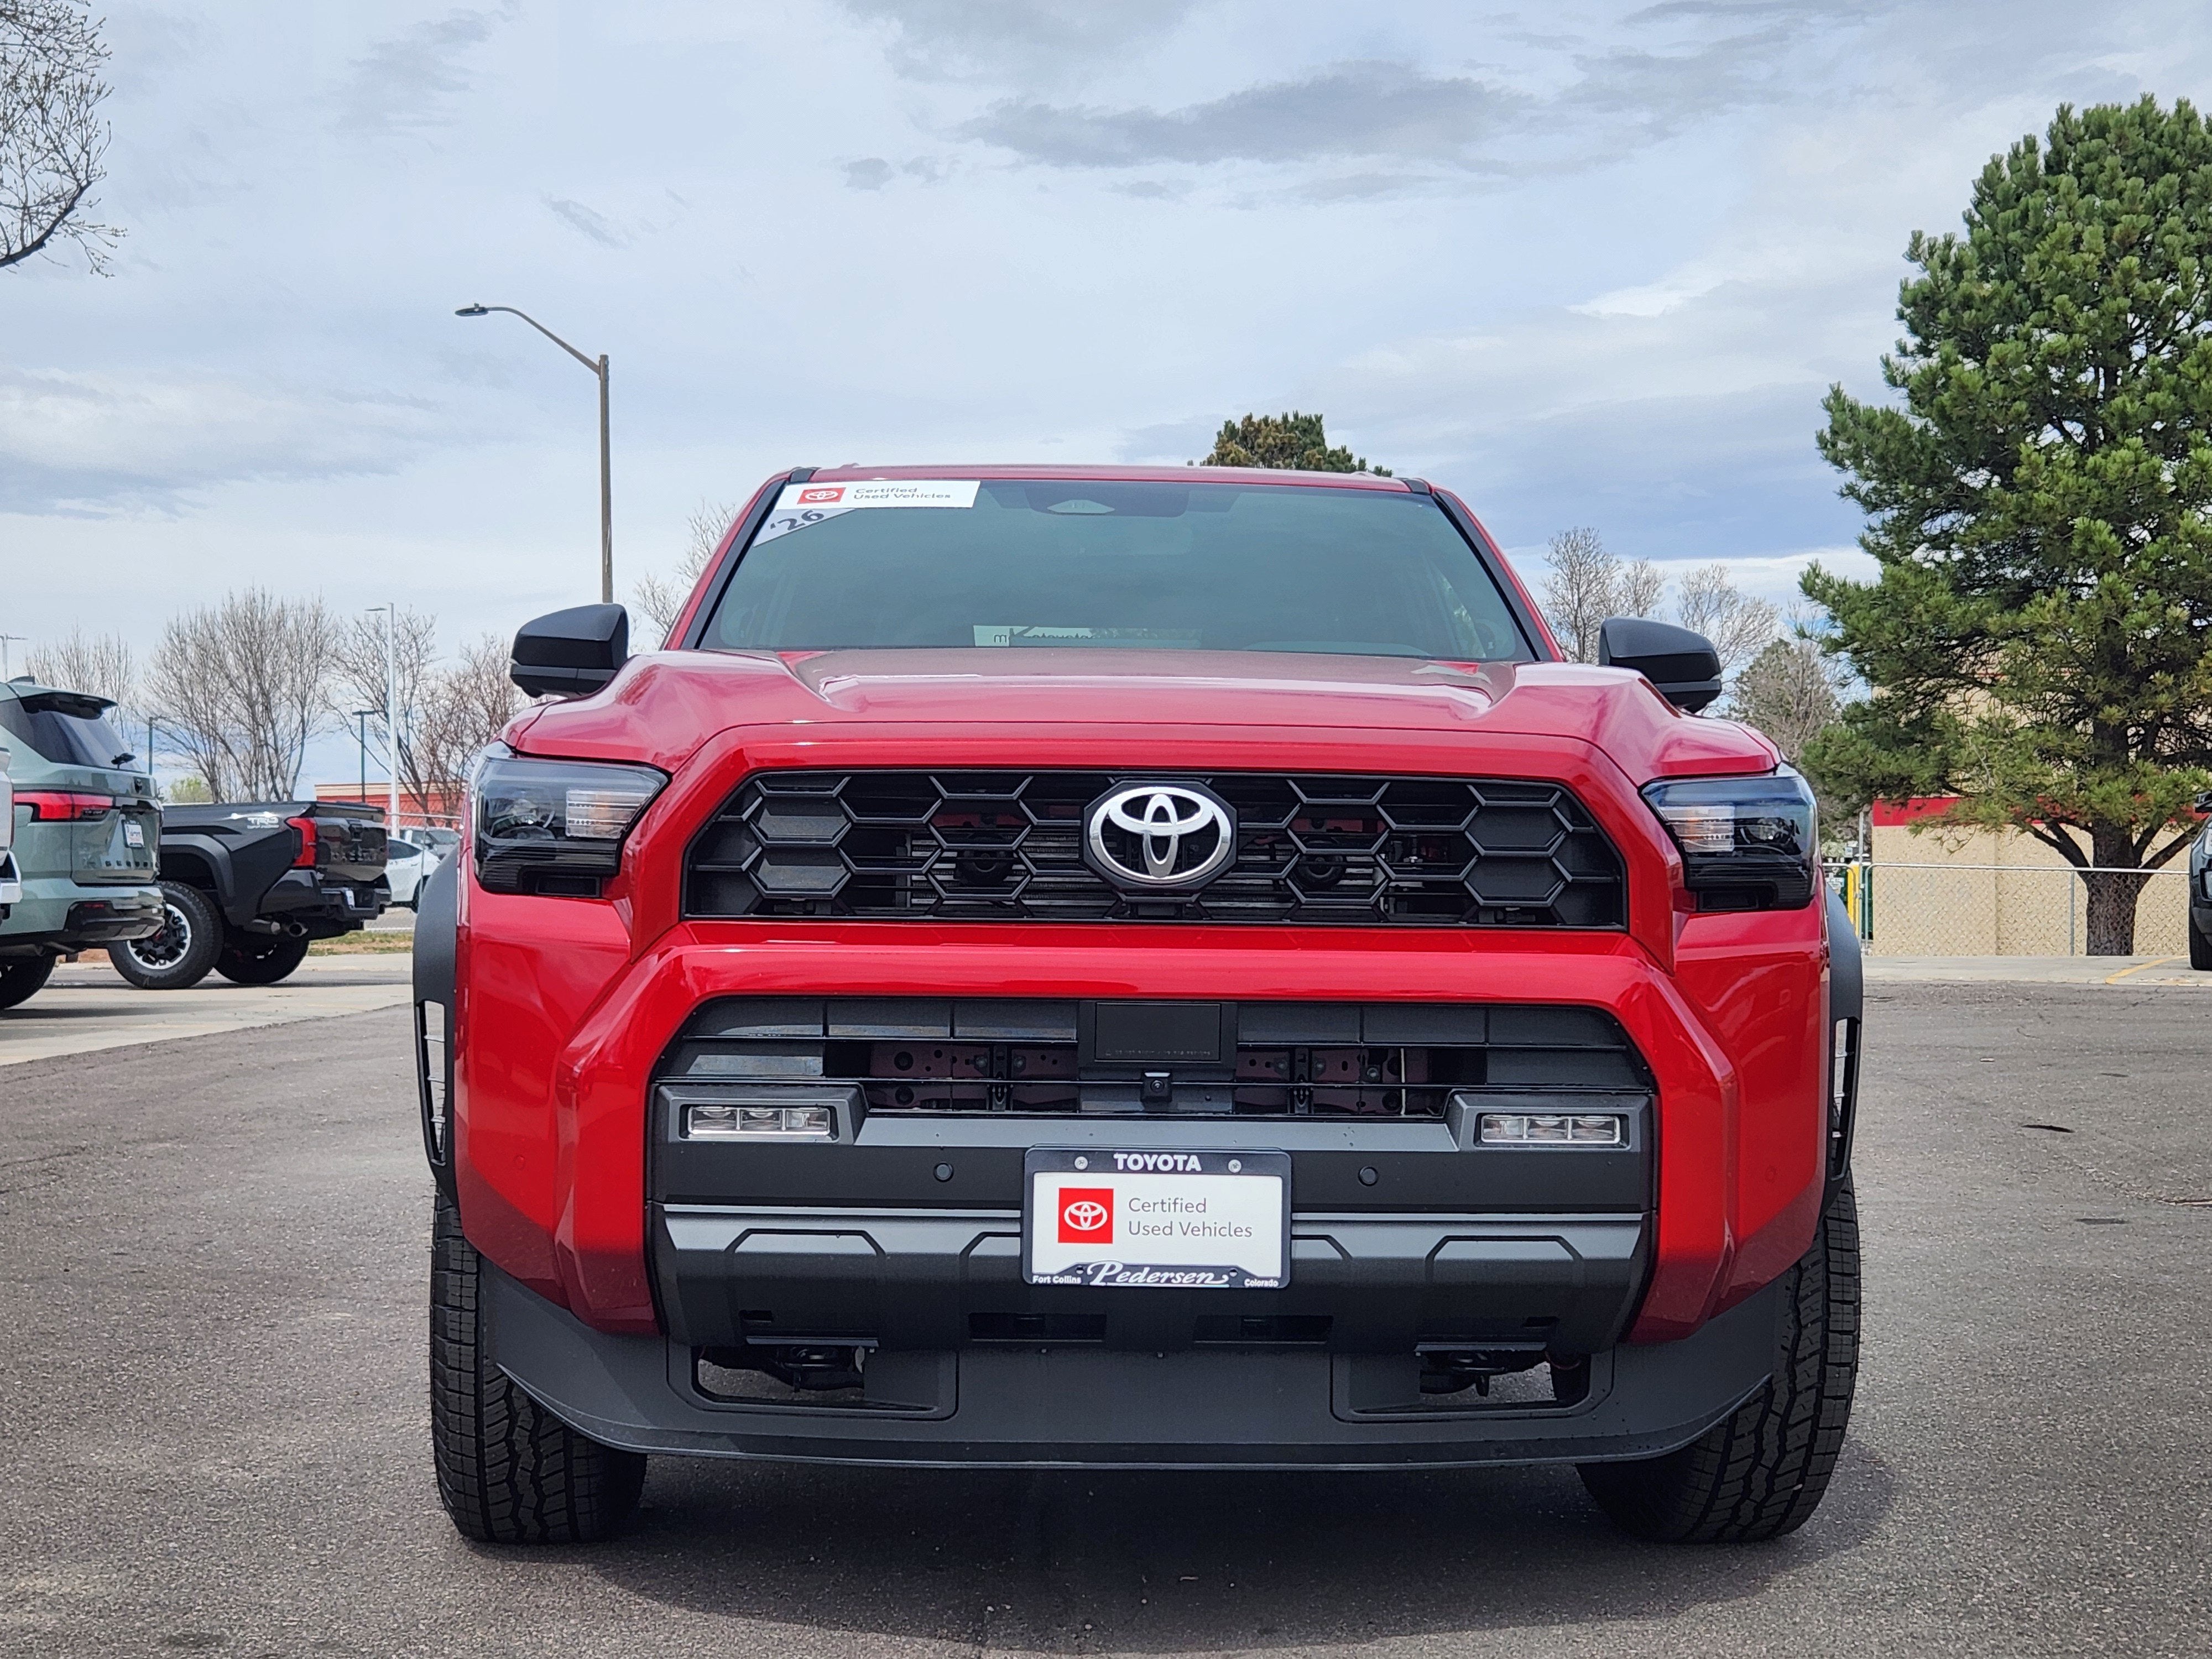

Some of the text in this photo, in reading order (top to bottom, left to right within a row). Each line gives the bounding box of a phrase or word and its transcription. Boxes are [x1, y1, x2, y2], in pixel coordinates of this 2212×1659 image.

[247, 817, 279, 825] TRD
[1113, 1153, 1202, 1172] TOYOTA
[1128, 1197, 1207, 1214] Certified
[1128, 1220, 1253, 1238] Used Vehicles
[1032, 1275, 1082, 1284] Fort Collins
[1087, 1260, 1229, 1288] Pedersen
[1244, 1278, 1279, 1289] Colorado
